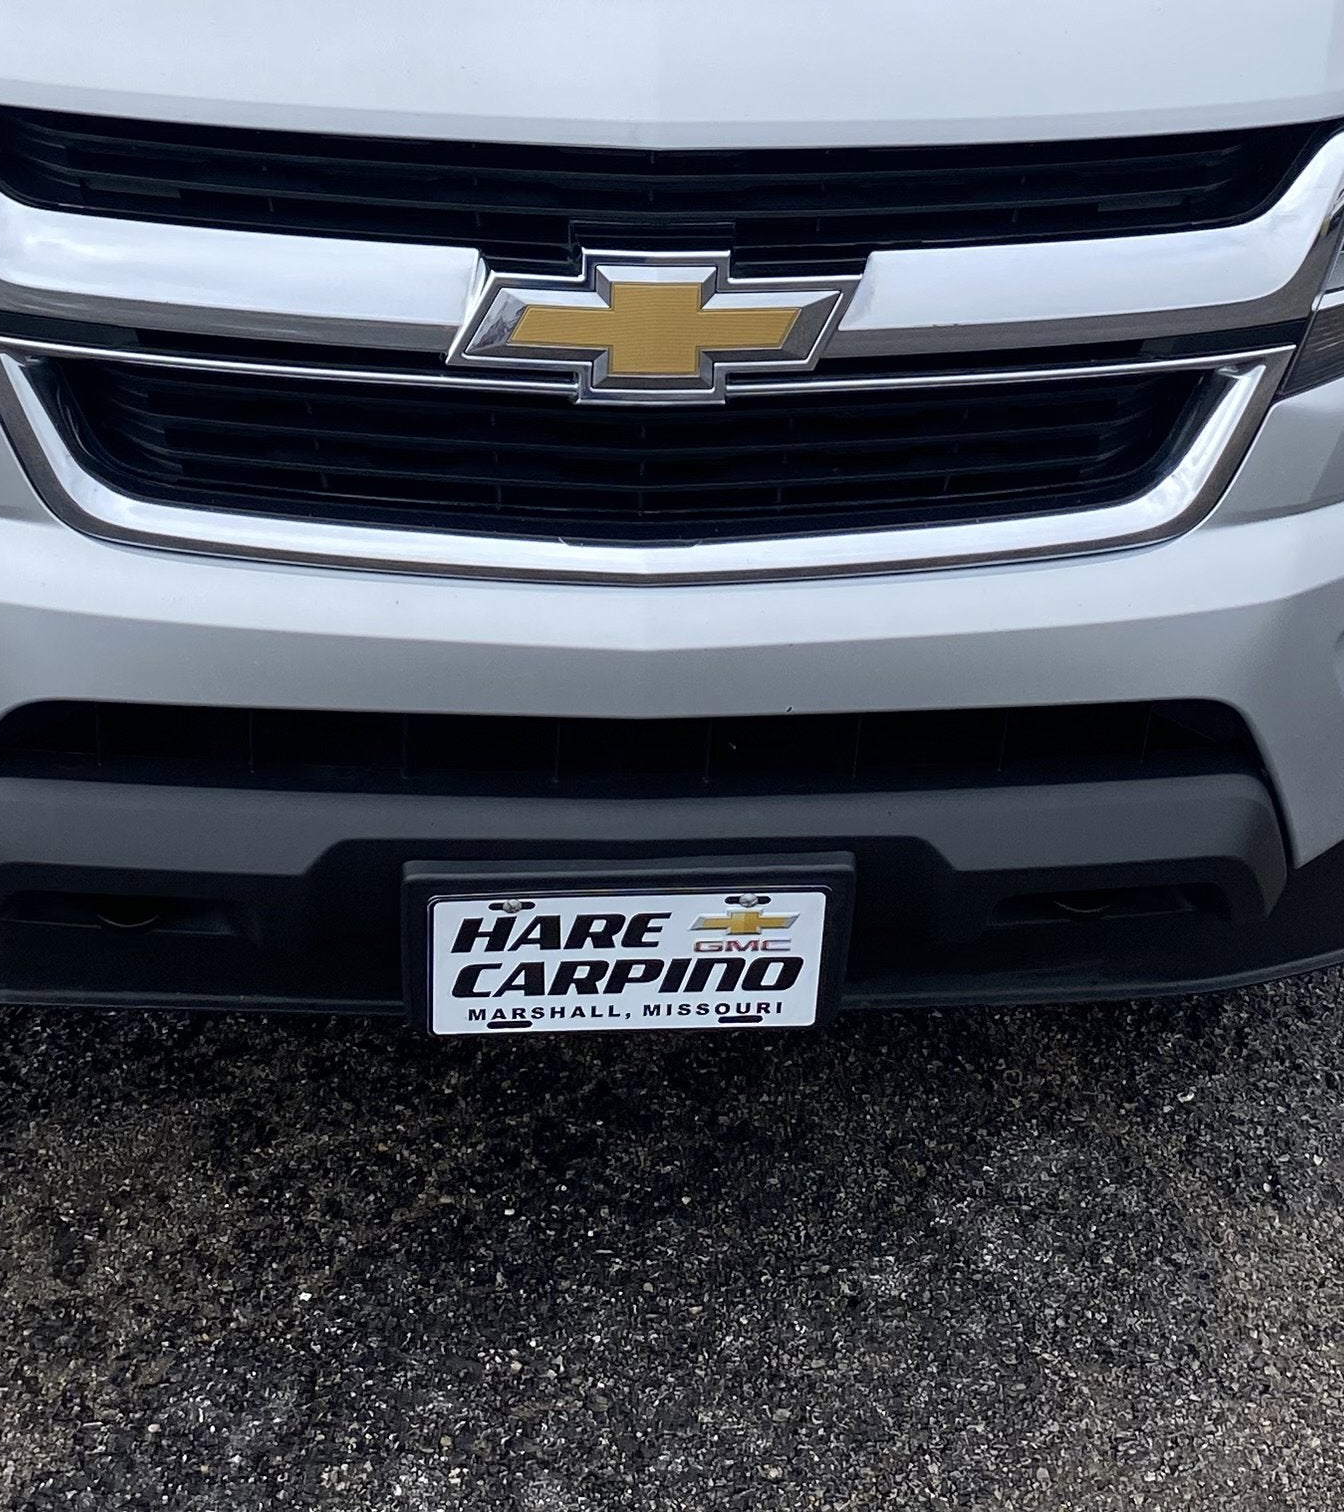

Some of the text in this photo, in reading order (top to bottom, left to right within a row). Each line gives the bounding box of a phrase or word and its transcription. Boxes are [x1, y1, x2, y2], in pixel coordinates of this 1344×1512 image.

[450, 911, 672, 954] HARE
[693, 939, 791, 953] GMC
[452, 956, 804, 998] CARPINO
[467, 1001, 783, 1021] MARSHALL, MISSOURI
